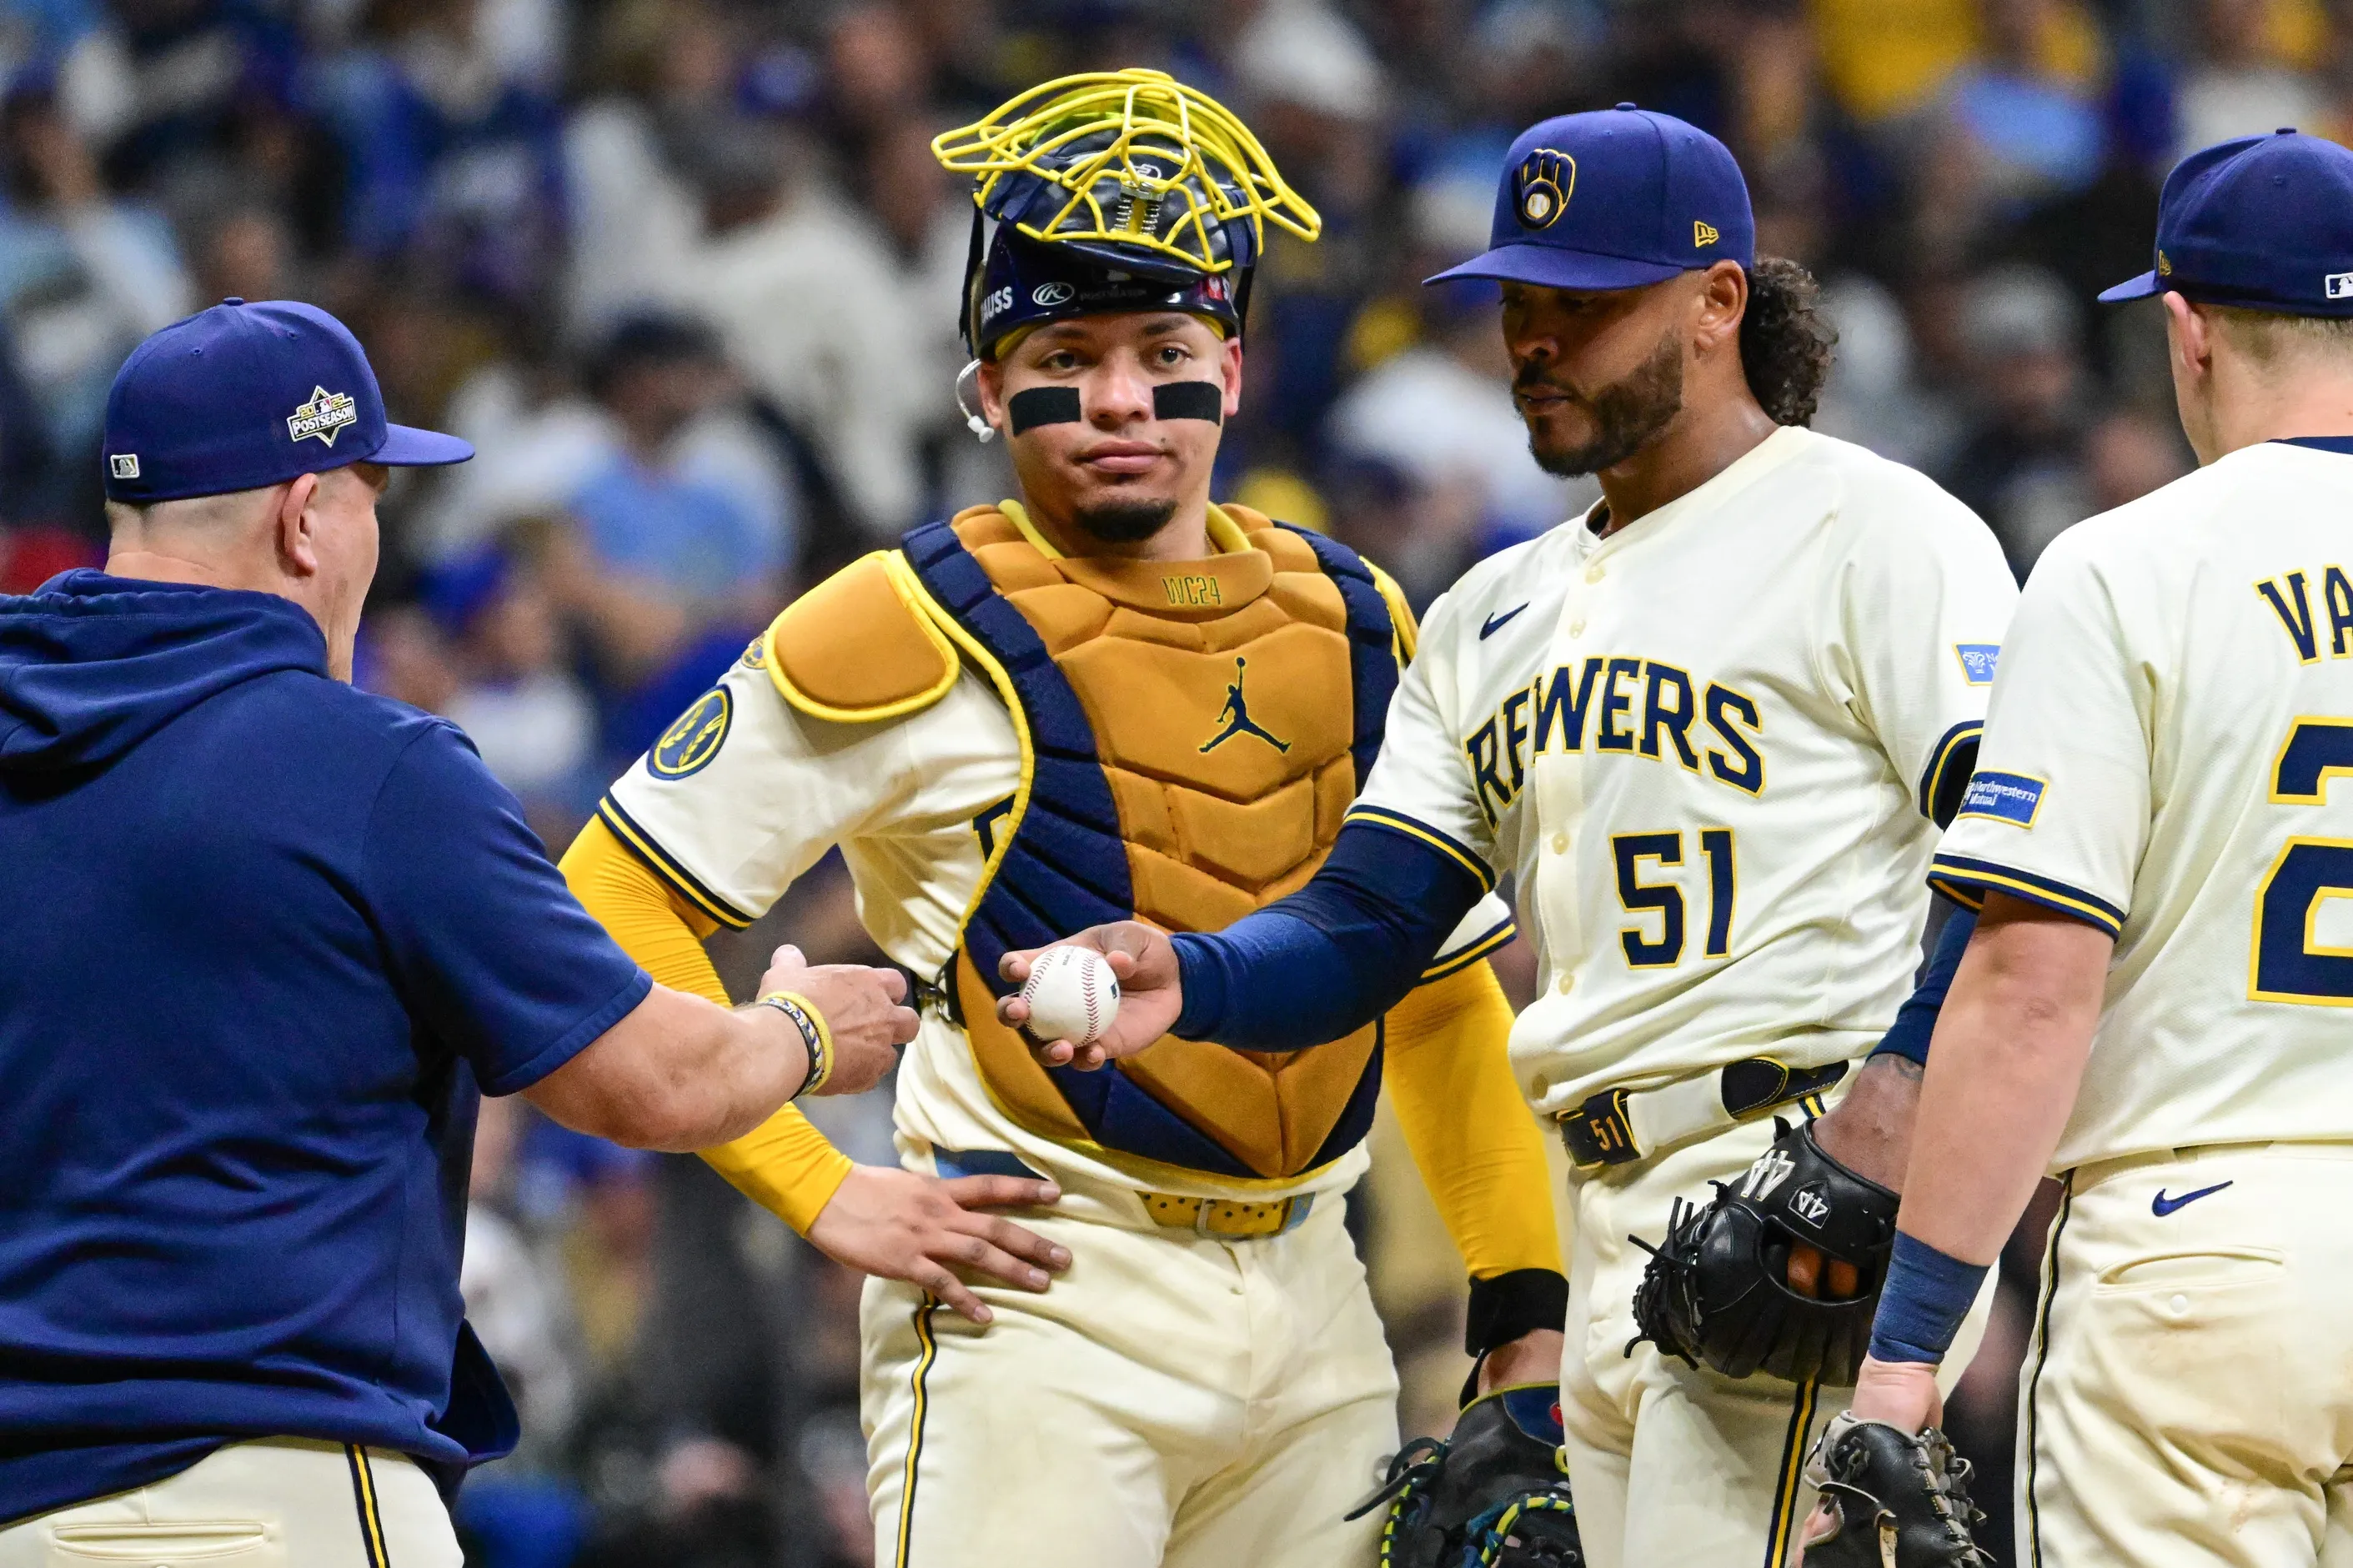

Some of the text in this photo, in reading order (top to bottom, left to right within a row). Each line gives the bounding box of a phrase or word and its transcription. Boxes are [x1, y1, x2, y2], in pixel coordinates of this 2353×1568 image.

[292, 405, 354, 434] POSTSEASON
[1161, 576, 1221, 605] WC24
[1969, 793, 1998, 806] Mutual
[1974, 780, 2037, 803] Northwestern
[1609, 827, 1737, 969] 51
[1589, 1115, 1623, 1150] 51
